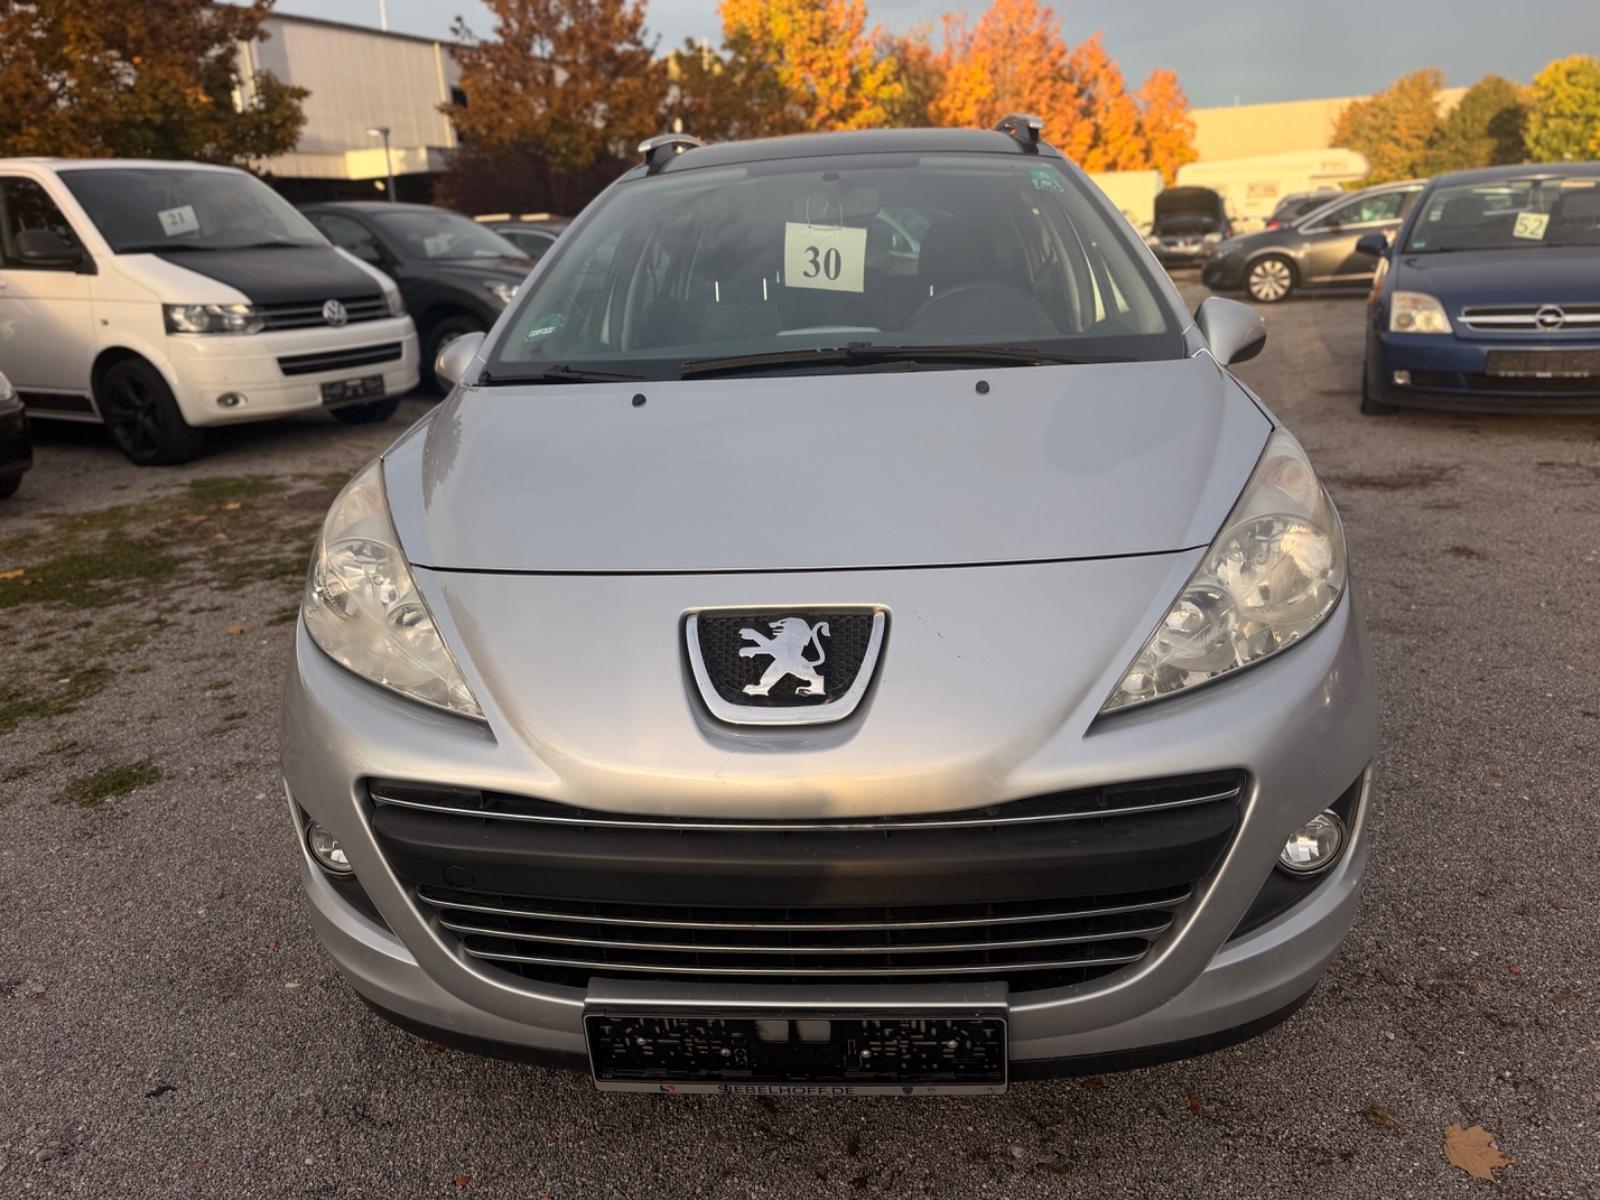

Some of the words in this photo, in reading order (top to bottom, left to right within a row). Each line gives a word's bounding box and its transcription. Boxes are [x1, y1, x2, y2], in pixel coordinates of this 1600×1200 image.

[168, 211, 186, 226] 21
[1517, 216, 1544, 236] 52
[803, 246, 842, 280] 30
